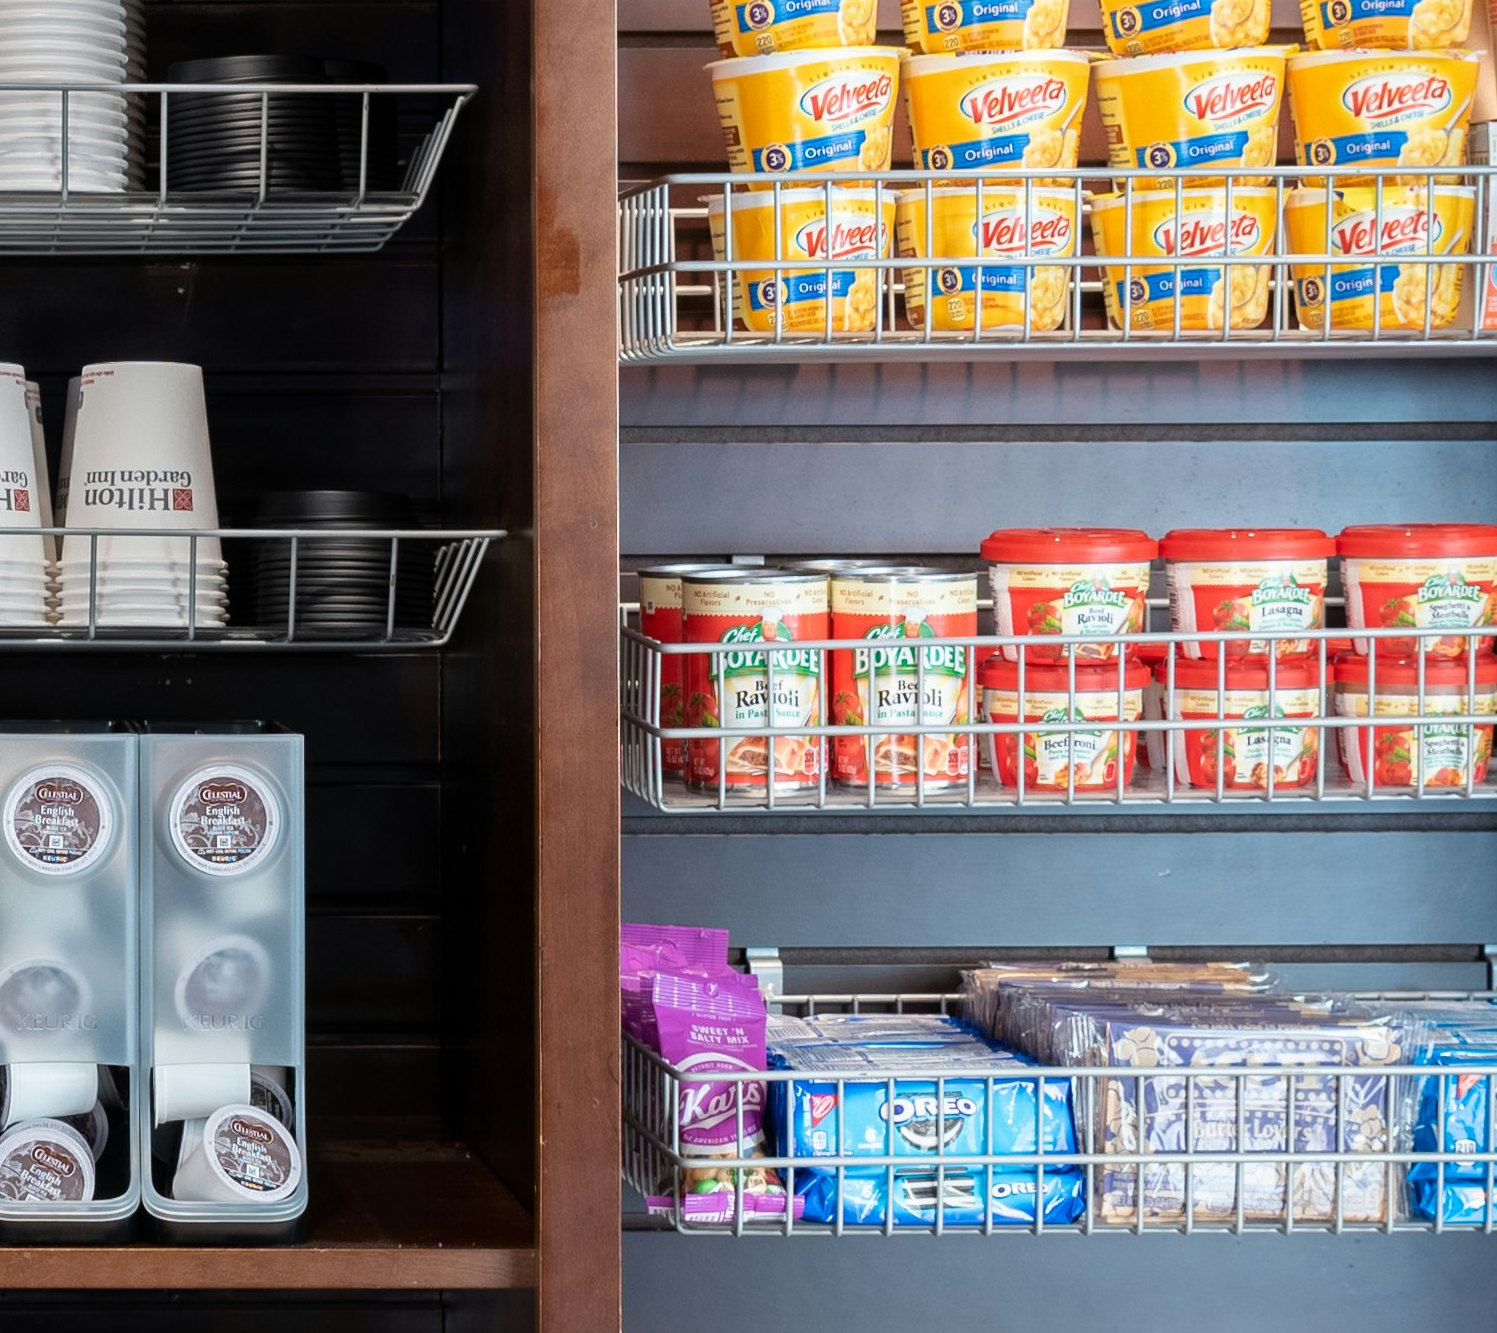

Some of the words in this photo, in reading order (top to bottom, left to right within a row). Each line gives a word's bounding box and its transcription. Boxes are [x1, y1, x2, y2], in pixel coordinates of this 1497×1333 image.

[973, 1, 1019, 17] Original
[1348, 77, 1448, 118] Velveeta
[1345, 138, 1391, 156] Original
[86, 471, 116, 485] Inn
[123, 470, 192, 487] Garden
[84, 488, 170, 511] Hilton
[1064, 591, 1125, 608] BOYARDEE
[1252, 588, 1310, 605] BOYARDEE
[1077, 612, 1113, 625] Ravioli
[1261, 606, 1303, 617] Lasagna
[40, 805, 74, 817] English
[35, 815, 78, 827] Breakfast
